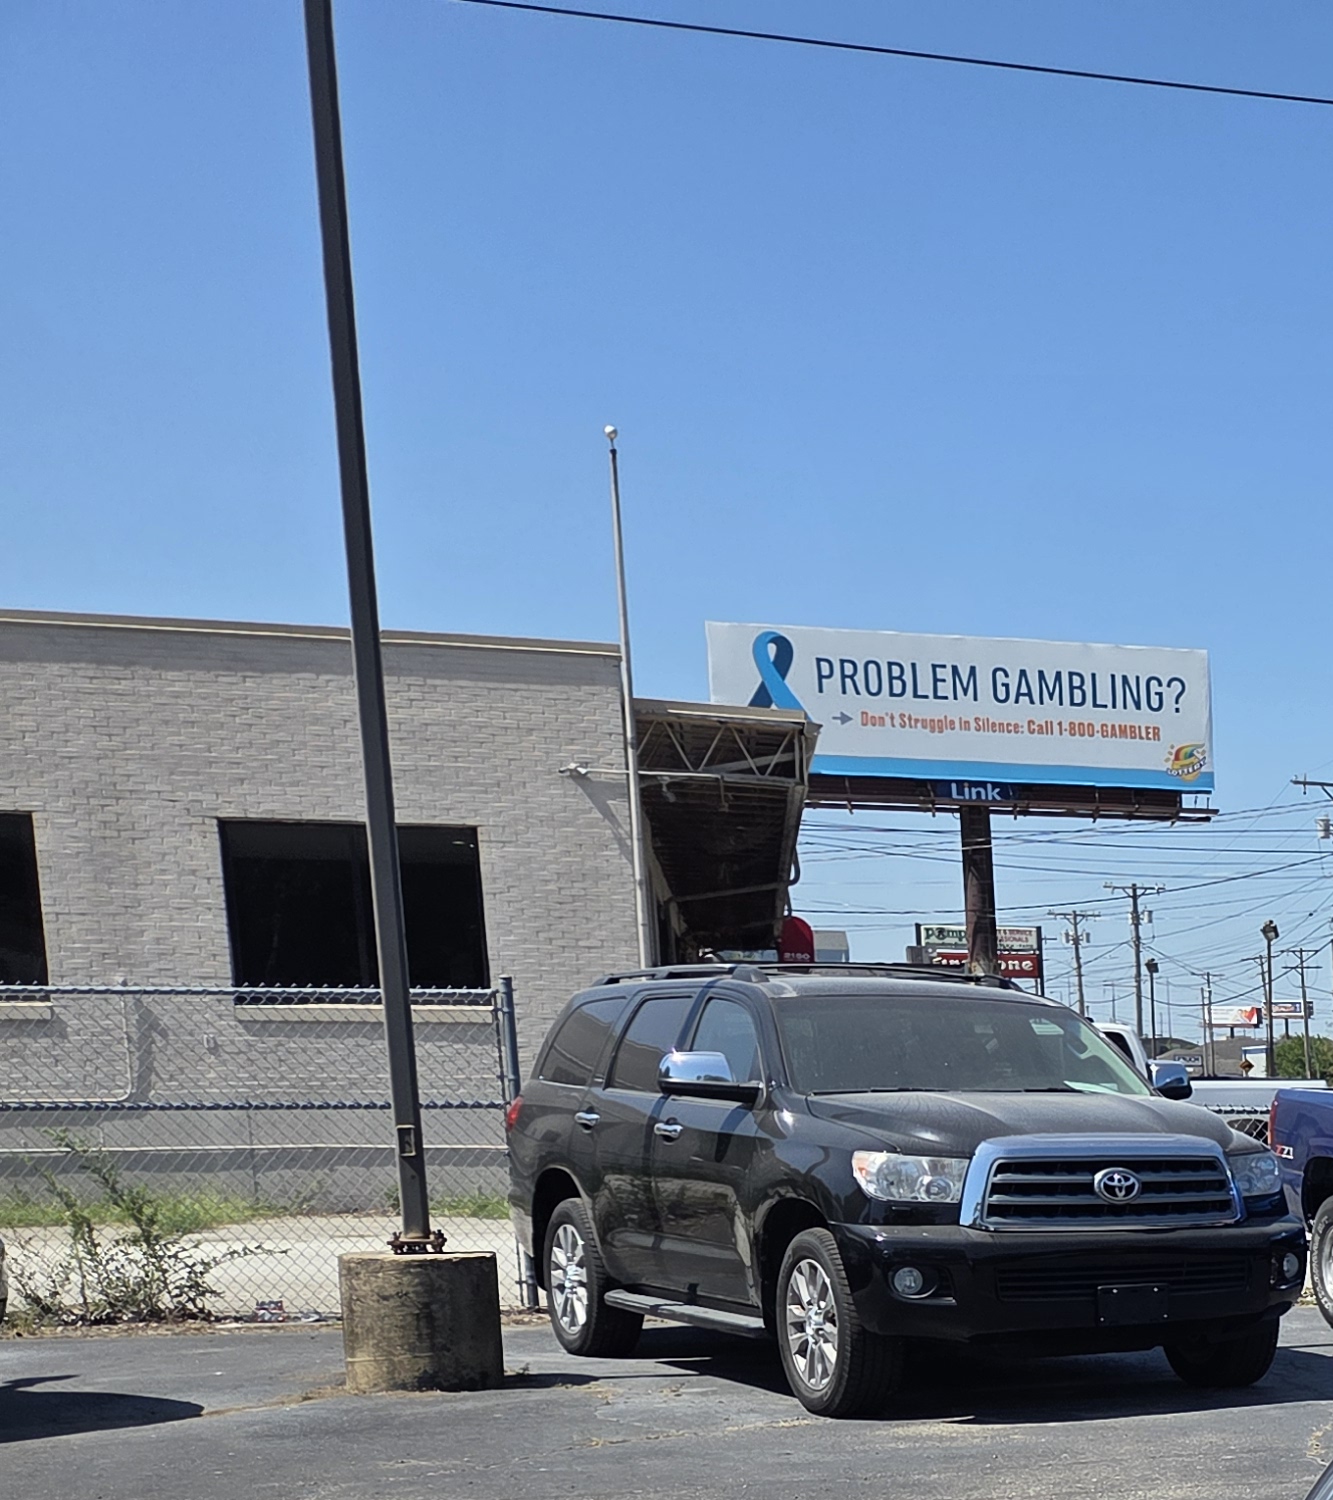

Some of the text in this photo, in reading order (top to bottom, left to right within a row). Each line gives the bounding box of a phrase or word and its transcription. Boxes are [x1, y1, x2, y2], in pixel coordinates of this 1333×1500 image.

[815, 657, 1187, 713] PROBLEM GAMBLING?
[861, 711, 896, 728] Don't
[899, 712, 956, 734] Struggle
[974, 716, 1025, 735] Silence:
[1027, 719, 1054, 736] Call
[1057, 720, 1161, 742] 1-800-GAMBLER
[951, 782, 1002, 801] Link
